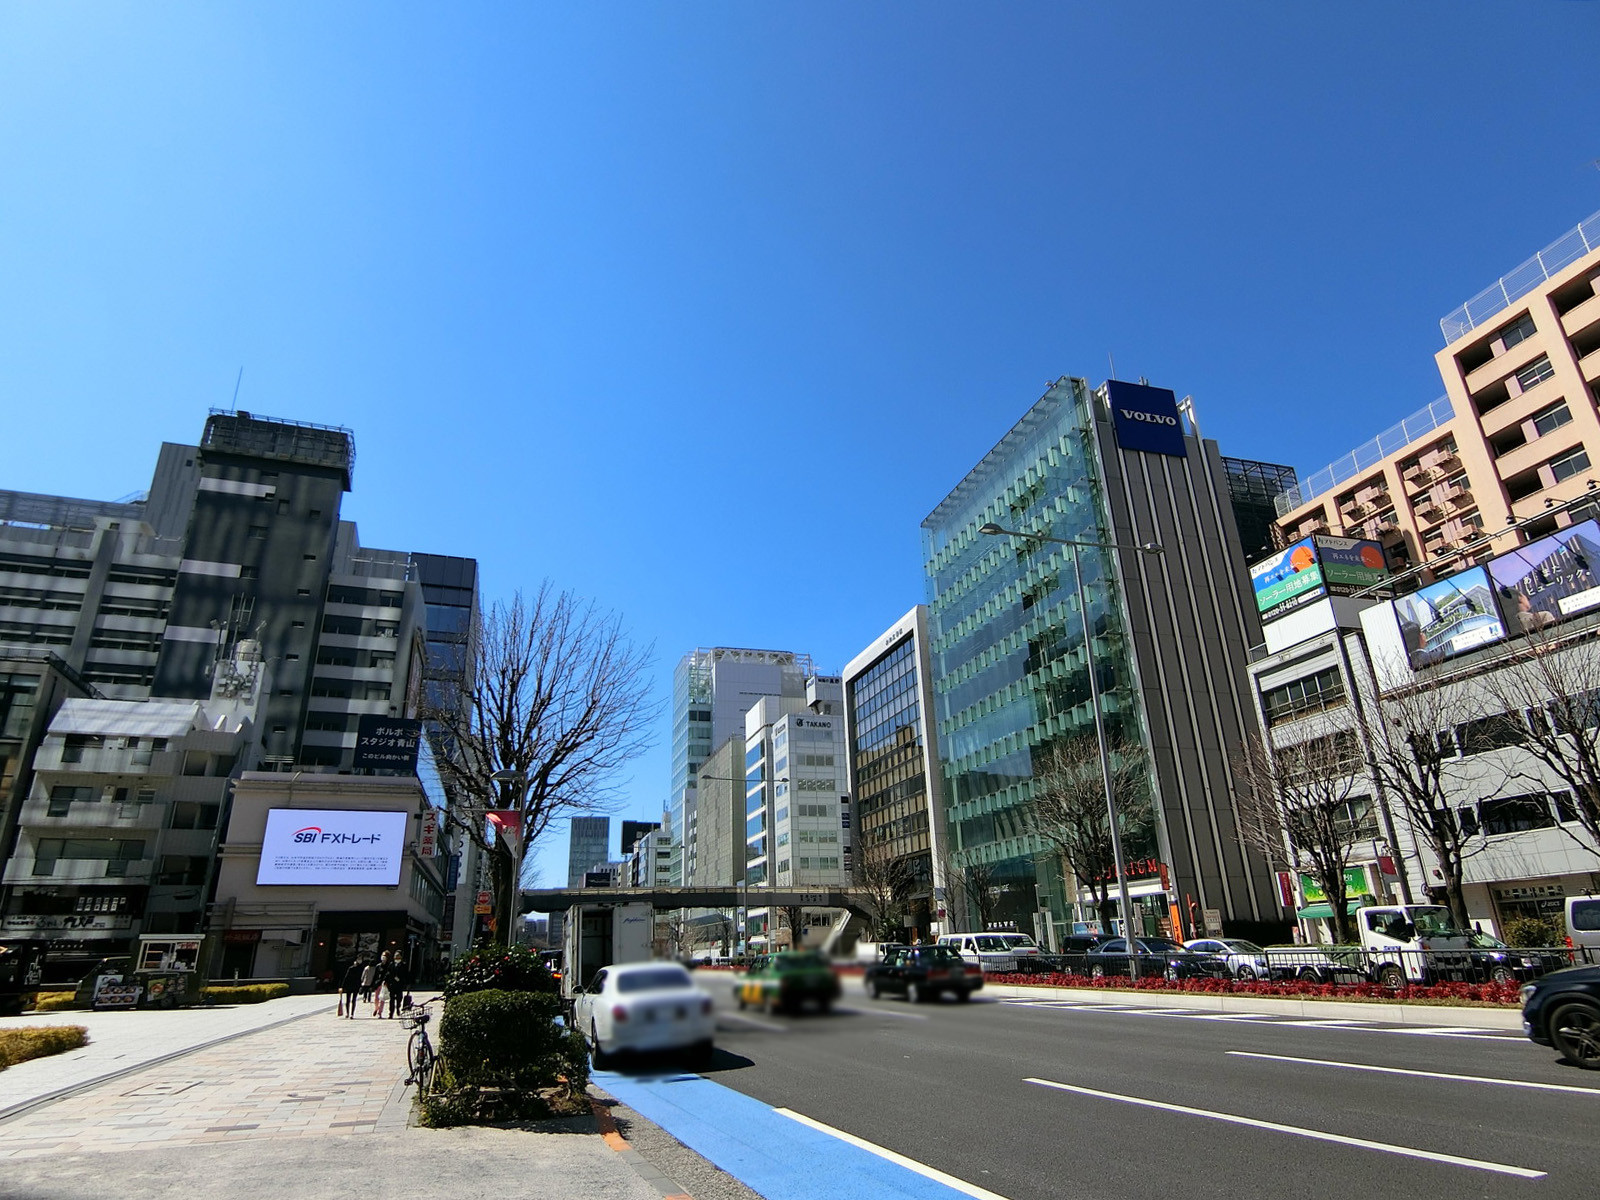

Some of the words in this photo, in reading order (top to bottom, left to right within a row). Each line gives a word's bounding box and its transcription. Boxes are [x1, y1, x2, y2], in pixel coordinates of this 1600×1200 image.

[1120, 409, 1177, 426] VOLVO
[376, 727, 404, 737] ボルボ
[361, 737, 416, 748] スタジオ青山
[294, 832, 317, 844] SBI
[321, 833, 382, 844] FXトレード
[421, 812, 436, 856] スギ薬局
